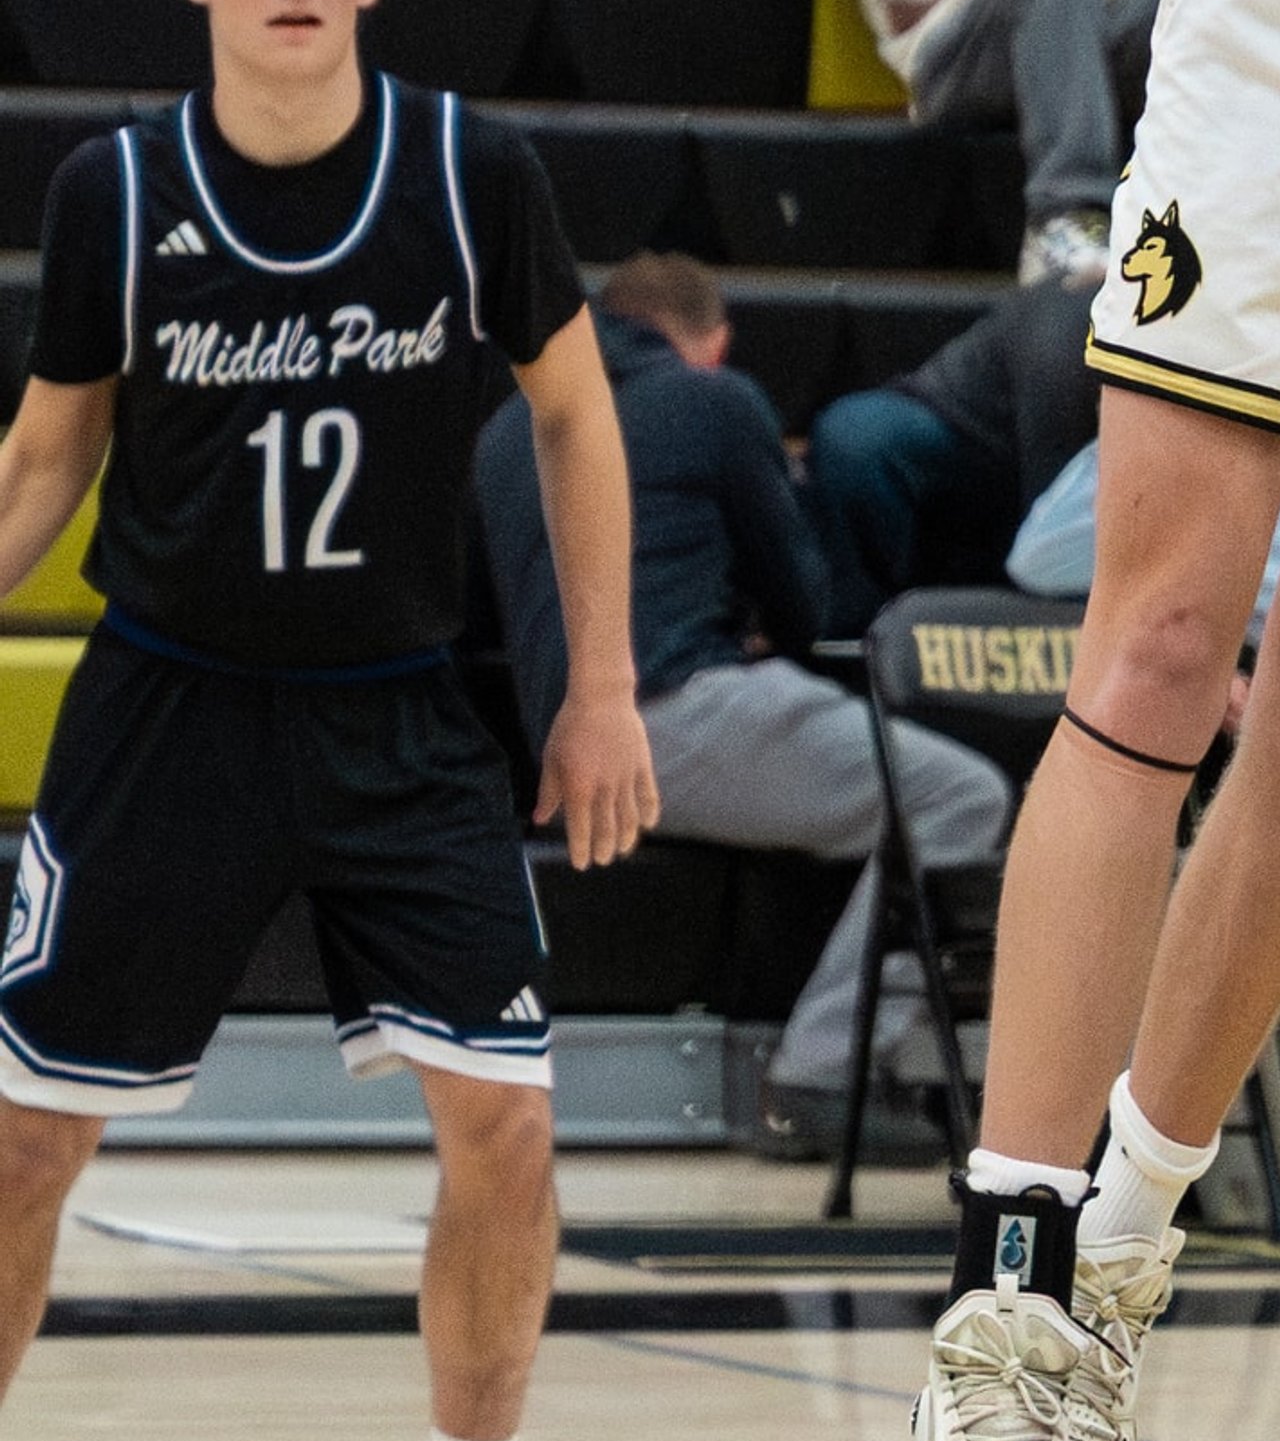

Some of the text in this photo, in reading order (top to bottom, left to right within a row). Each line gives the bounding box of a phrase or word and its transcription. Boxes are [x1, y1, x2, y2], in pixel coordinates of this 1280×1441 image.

[156, 296, 451, 387] Middle Park
[247, 407, 364, 572] 12
